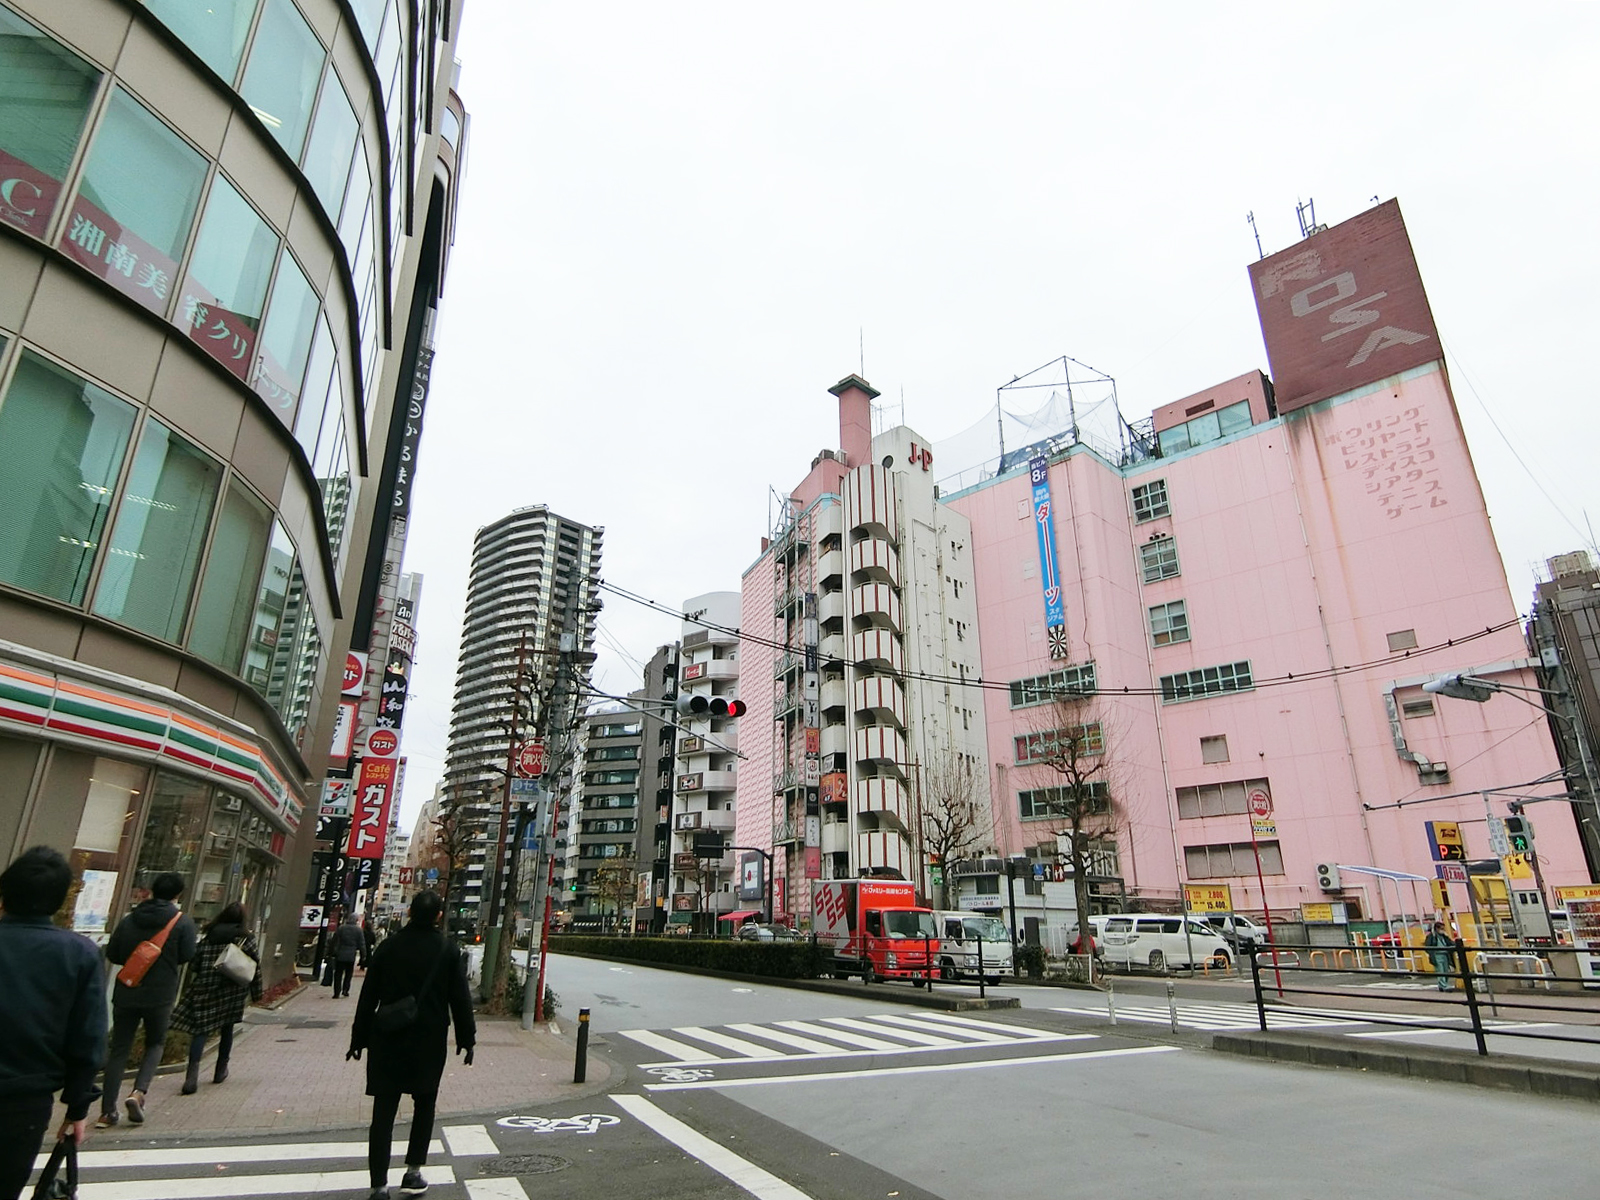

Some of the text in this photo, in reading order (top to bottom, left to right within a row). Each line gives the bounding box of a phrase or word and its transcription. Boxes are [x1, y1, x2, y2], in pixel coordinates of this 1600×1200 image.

[1258, 249, 1430, 368] ROSA
[1325, 404, 1425, 446] ボウリング
[1341, 418, 1429, 456] ビリヤード
[1344, 436, 1431, 470] レストラン
[1031, 469, 1047, 483] 8F
[1386, 495, 1448, 520] ゲーム
[1036, 502, 1059, 607] ダーツ
[372, 740, 395, 749] ガスト
[366, 763, 391, 773] Café
[356, 784, 387, 850] ガスト
[1440, 844, 1449, 859] P
[359, 859, 373, 887] 2F
